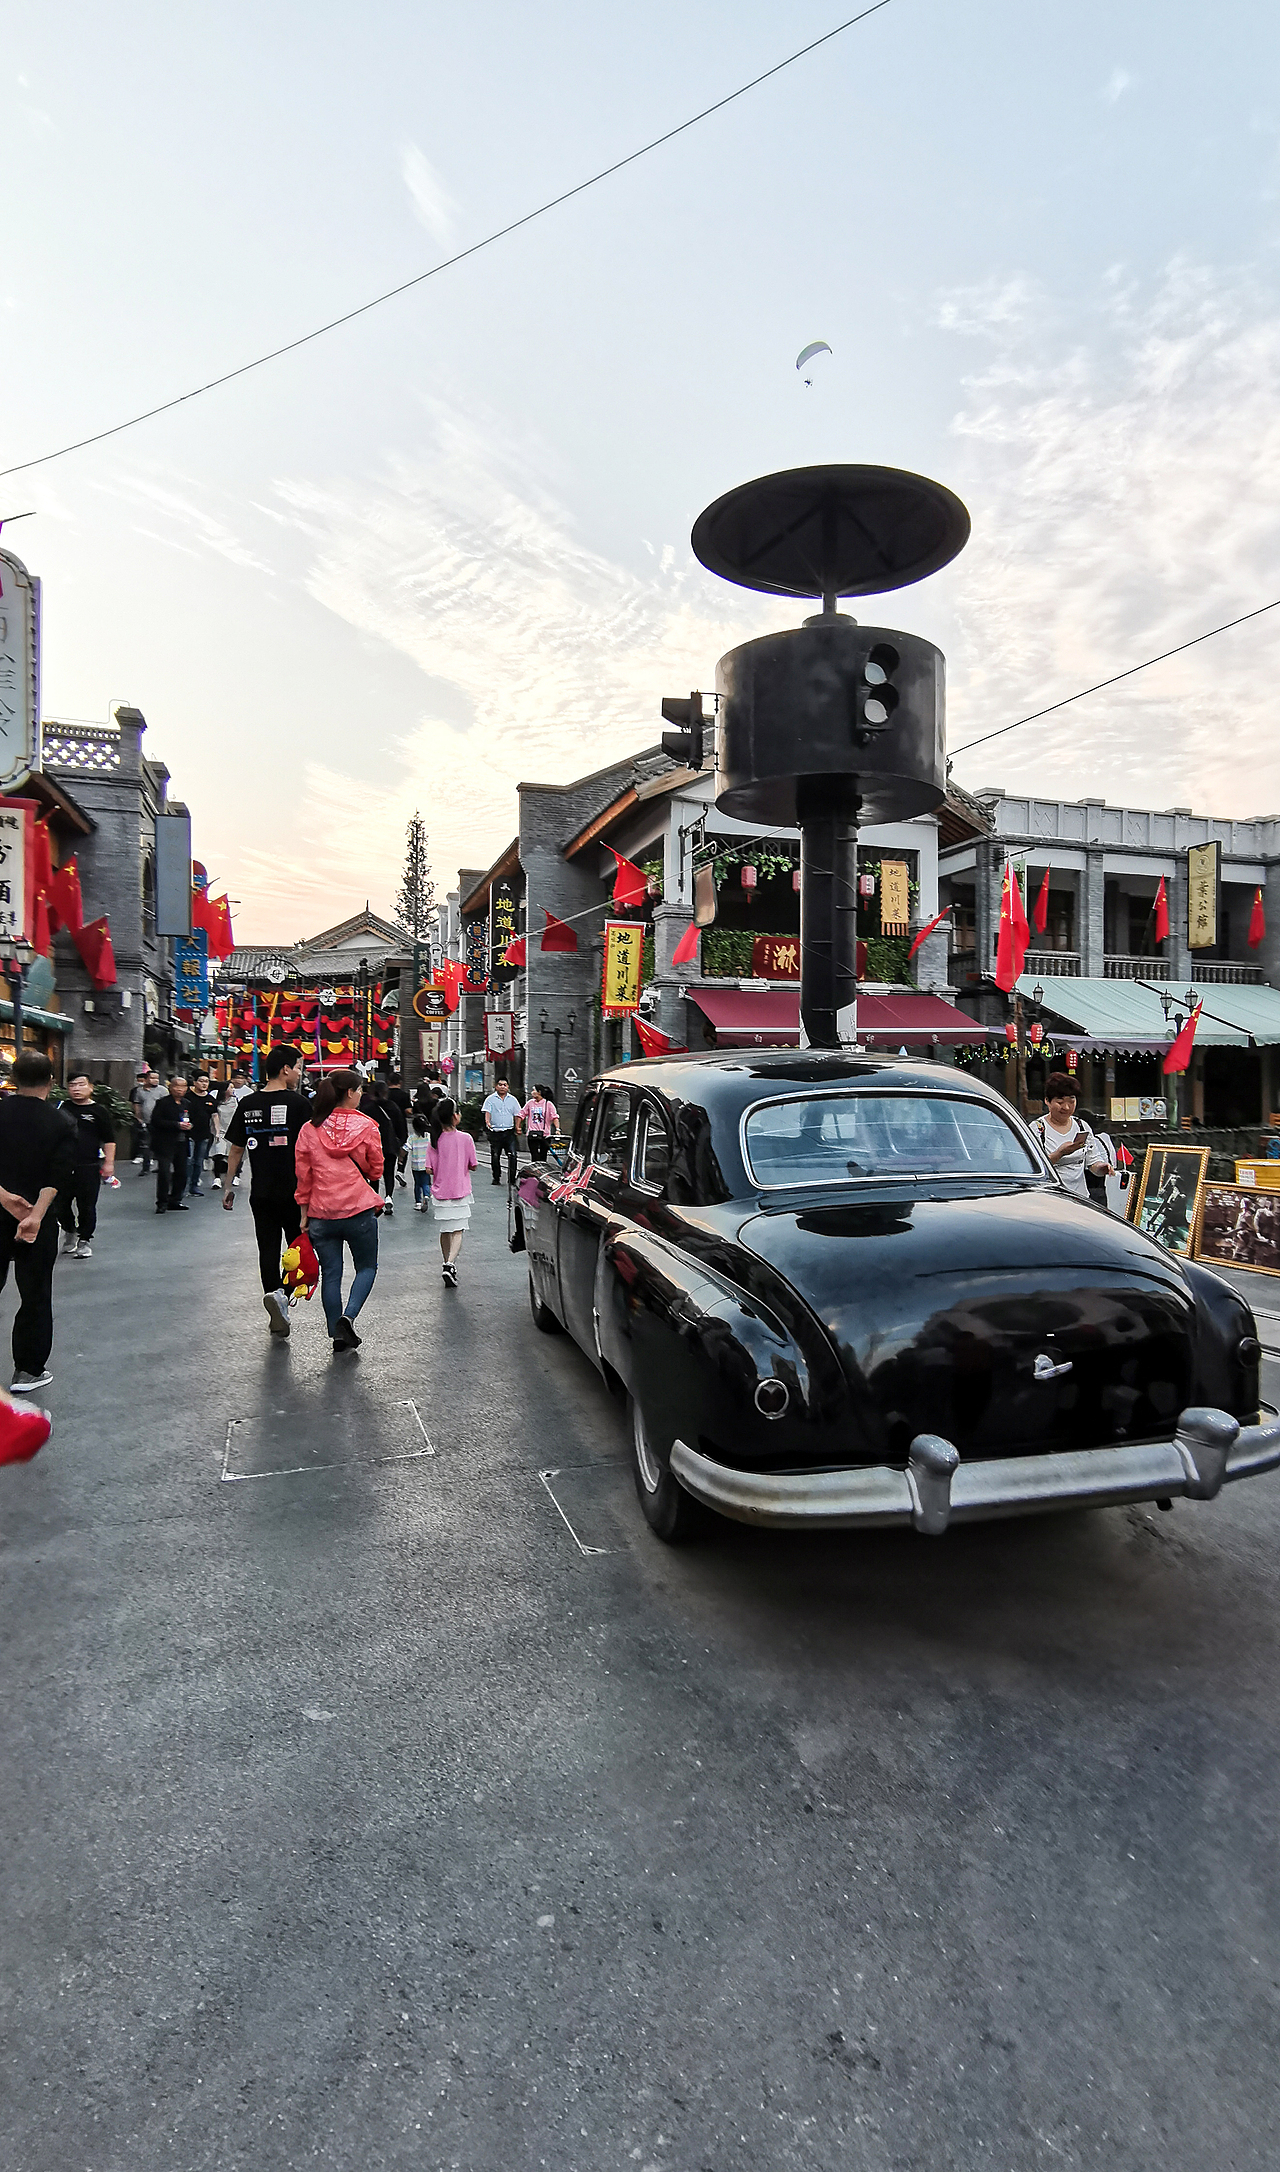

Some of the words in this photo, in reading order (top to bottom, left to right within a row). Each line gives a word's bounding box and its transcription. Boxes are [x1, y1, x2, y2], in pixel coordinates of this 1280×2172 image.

[889, 868, 902, 920] 地道川菜
[615, 932, 633, 1002] 地道川菜
